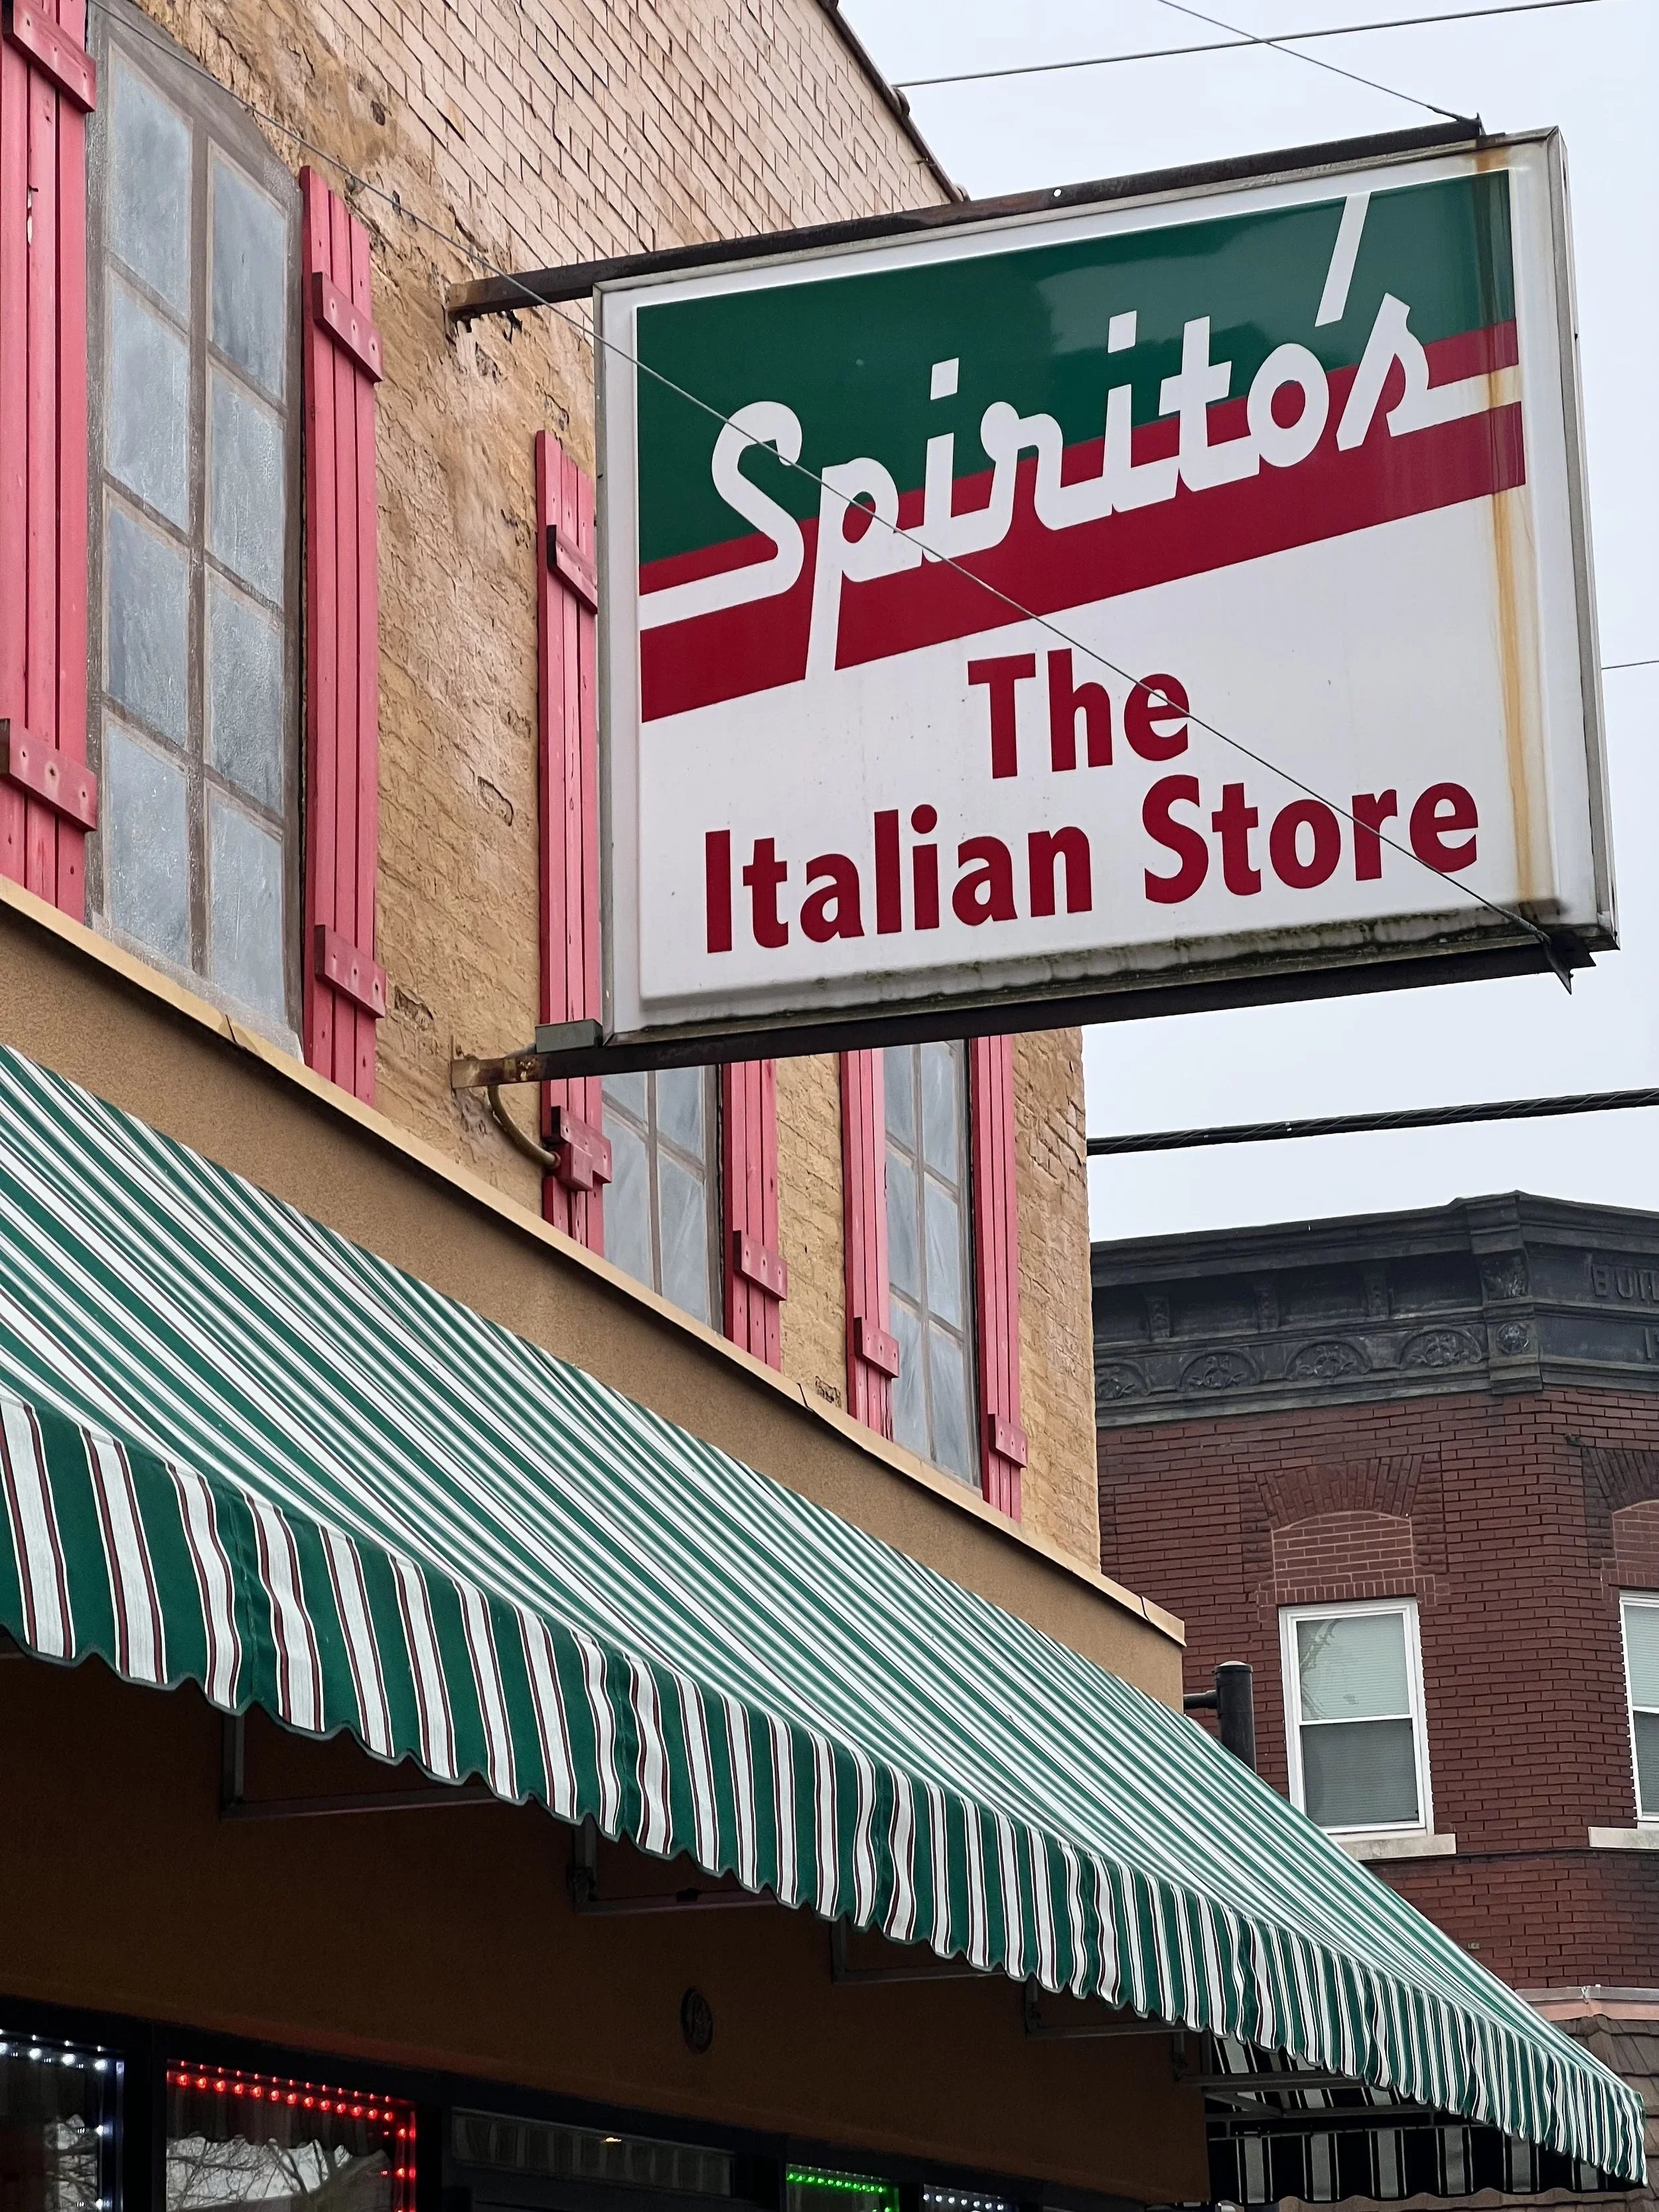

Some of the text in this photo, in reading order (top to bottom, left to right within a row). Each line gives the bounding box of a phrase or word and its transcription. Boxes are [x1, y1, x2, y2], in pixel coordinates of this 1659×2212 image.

[640, 191, 1524, 681] Spirito's
[967, 648, 1190, 778] The
[705, 774, 1479, 954] Italian Store
